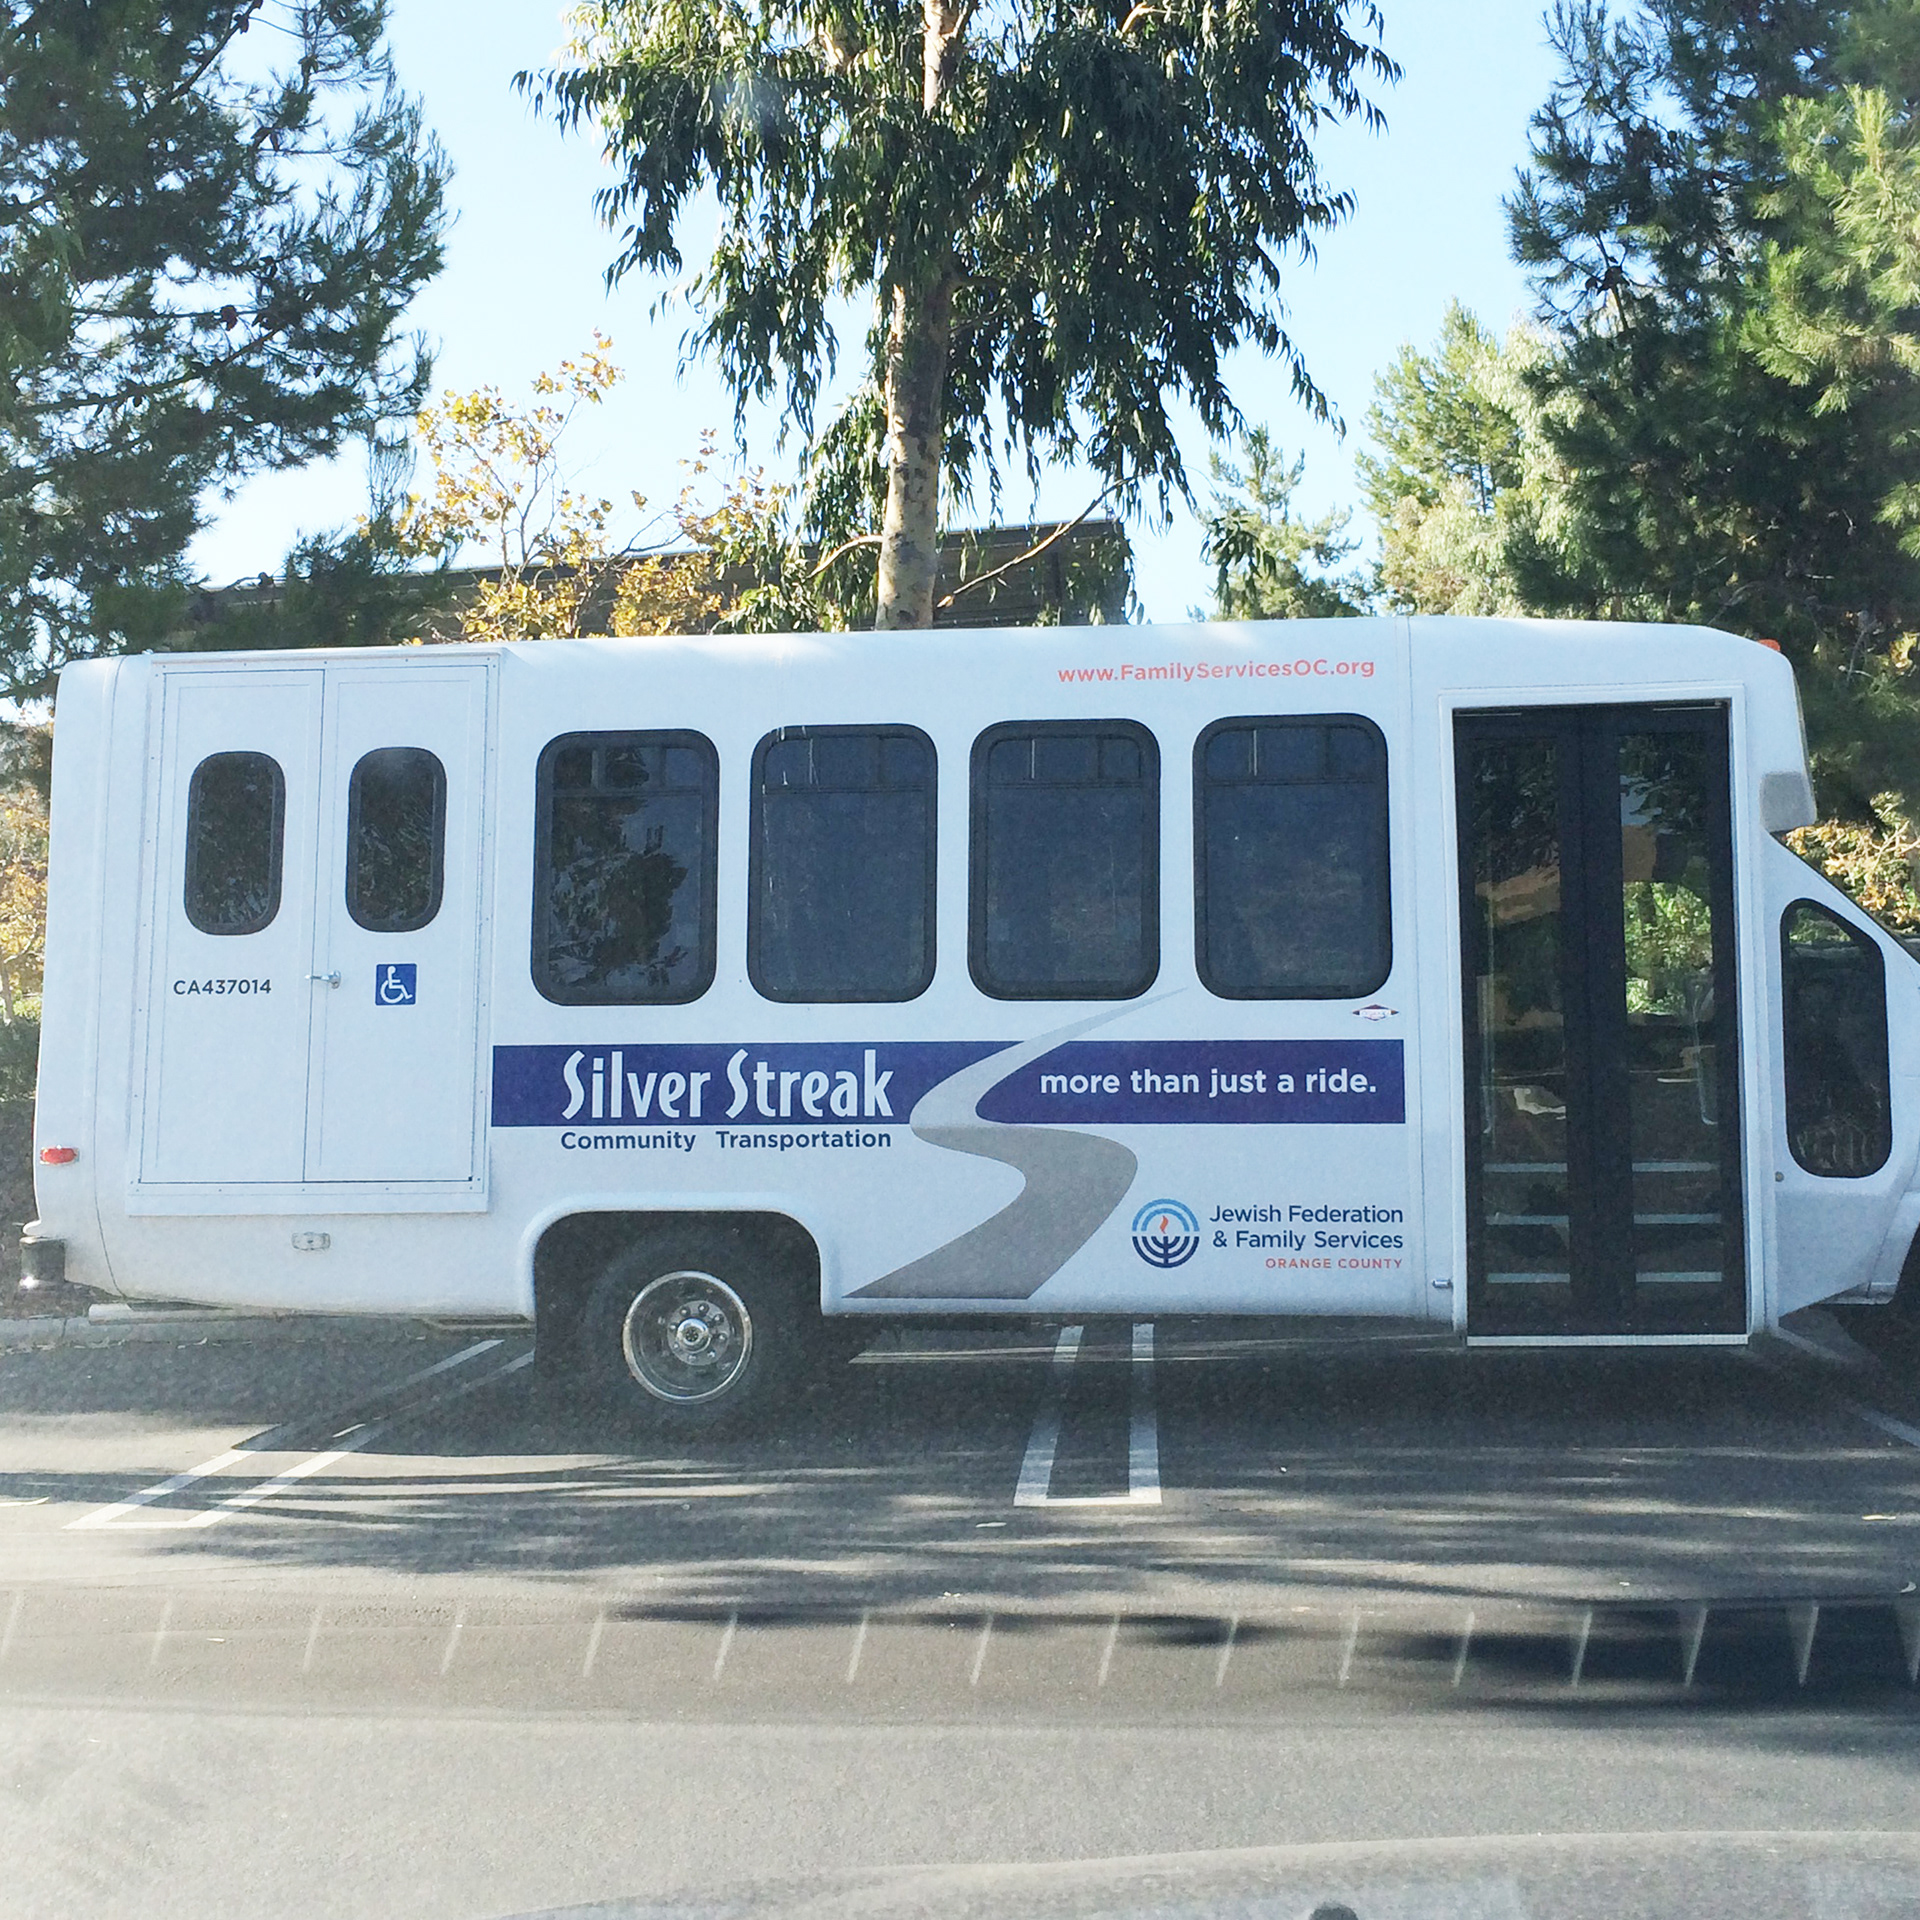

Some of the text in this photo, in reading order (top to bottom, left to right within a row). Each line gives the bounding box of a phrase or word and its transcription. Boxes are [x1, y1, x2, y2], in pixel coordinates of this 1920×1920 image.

[1057, 658, 1376, 683] www.FamilyServicesOC.org
[173, 979, 272, 995] CA437014
[562, 1048, 894, 1120] Silver Streak
[1040, 1067, 1377, 1098] more than just a ride.
[560, 1128, 891, 1152] Community Transportation
[1209, 1204, 1404, 1223] Jewish Federation
[1212, 1229, 1404, 1251] & Family Services
[1265, 1257, 1403, 1269] ORANGE COUNTY
